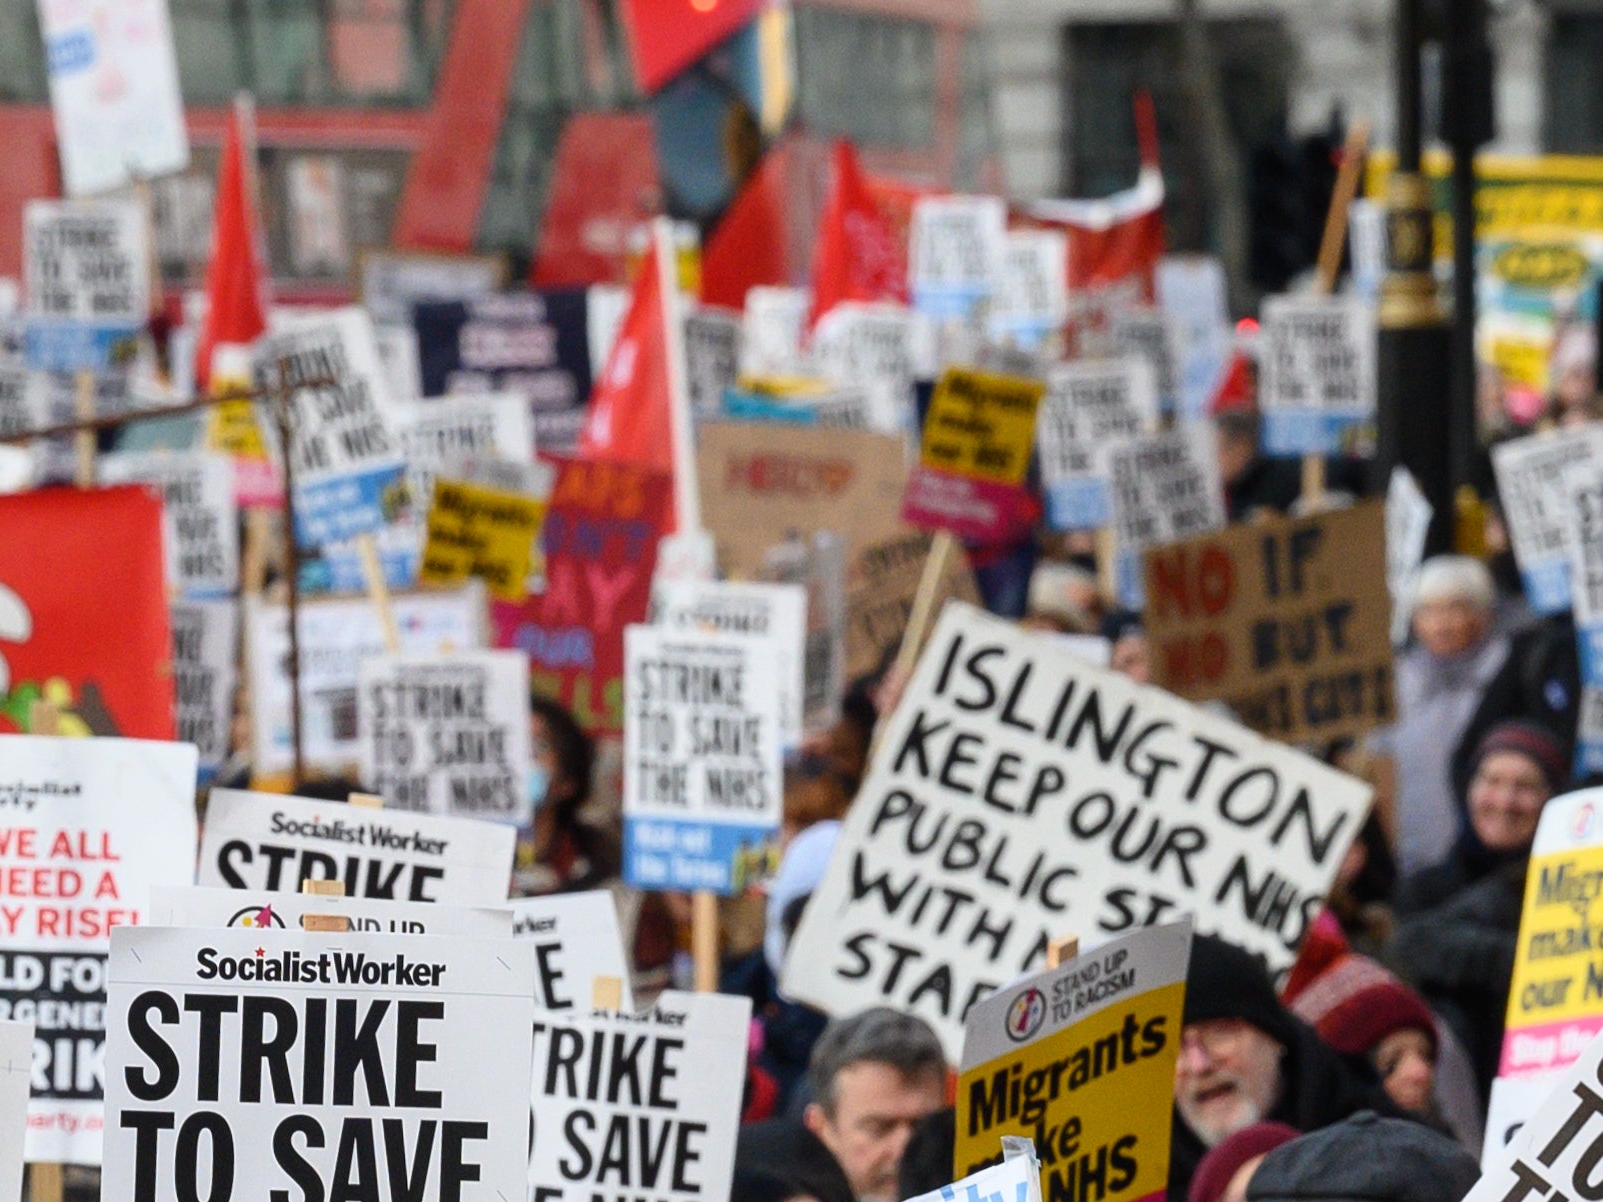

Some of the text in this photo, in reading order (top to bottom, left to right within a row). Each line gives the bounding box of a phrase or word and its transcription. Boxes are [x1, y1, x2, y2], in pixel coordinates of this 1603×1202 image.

[893, 710, 1065, 817] KEEP
[1069, 793, 1210, 889] OUR
[934, 634, 1348, 866] ISLINGTON
[50, 829, 121, 862] ALL
[94, 870, 119, 900] A
[870, 789, 1079, 912] PUBLIC
[850, 851, 1014, 962] WITH
[1051, 947, 1129, 1001] STAND UP
[1051, 967, 1137, 1025] TO RACISM
[123, 989, 446, 1110] STRIKE
[967, 1012, 1169, 1138] Migrants
[558, 1109, 708, 1194] SAVE
